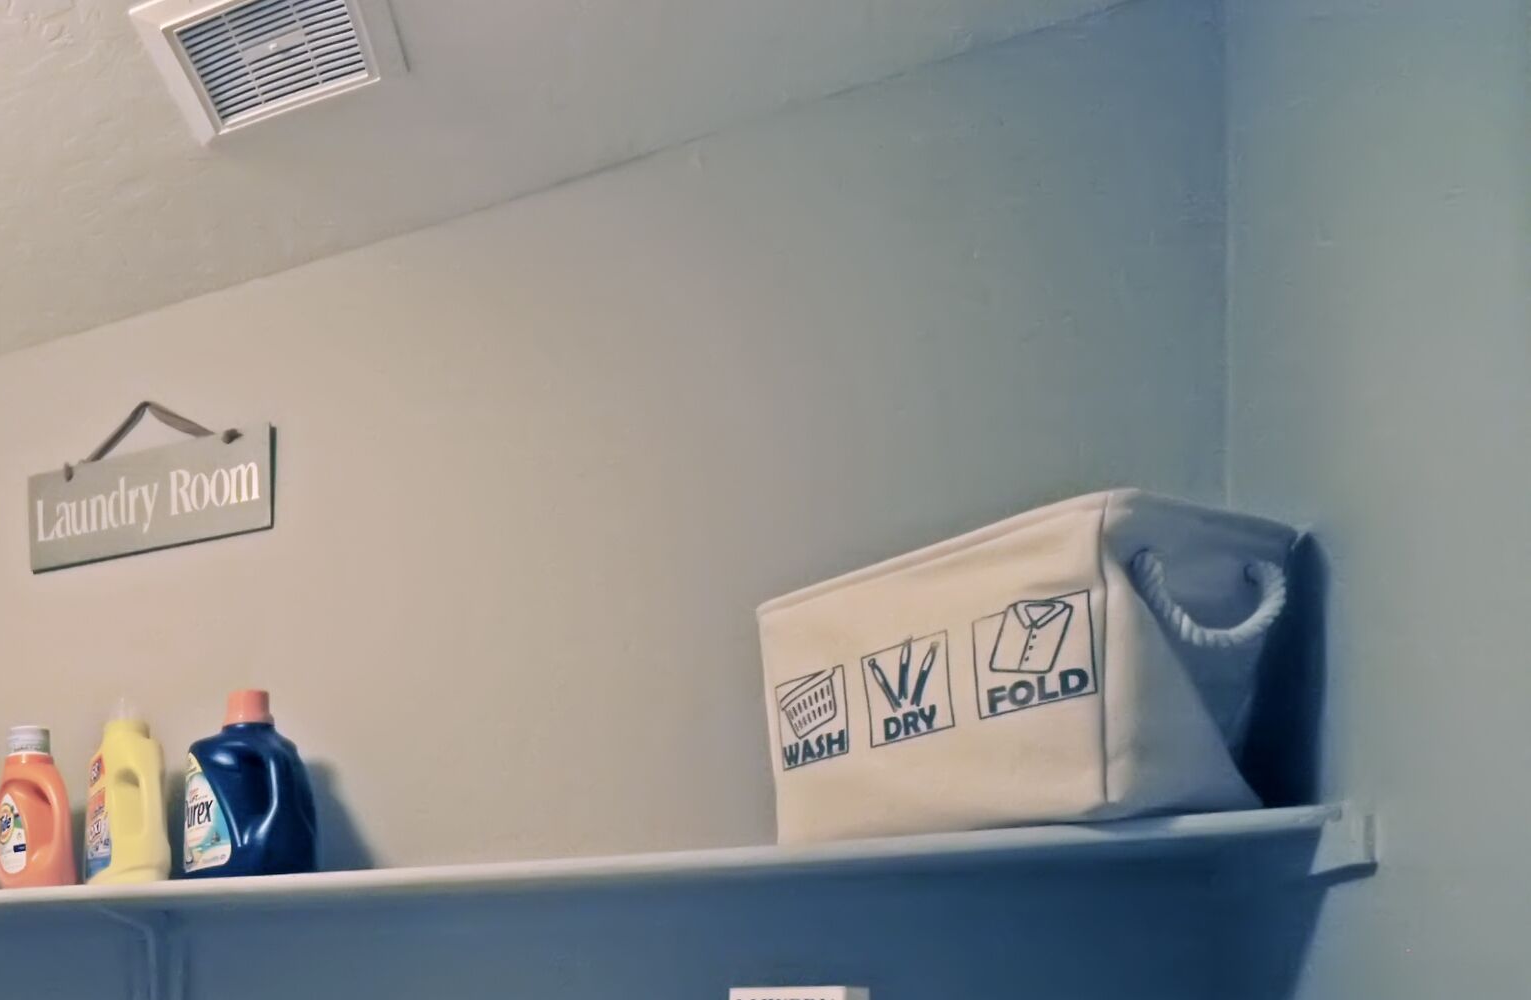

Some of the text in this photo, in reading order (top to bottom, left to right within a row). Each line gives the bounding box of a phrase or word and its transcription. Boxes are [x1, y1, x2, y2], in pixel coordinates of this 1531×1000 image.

[36, 461, 260, 542] Laundry Room
[987, 668, 1089, 714] FOLD
[883, 704, 937, 741] DRY
[783, 729, 846, 766] WASH
